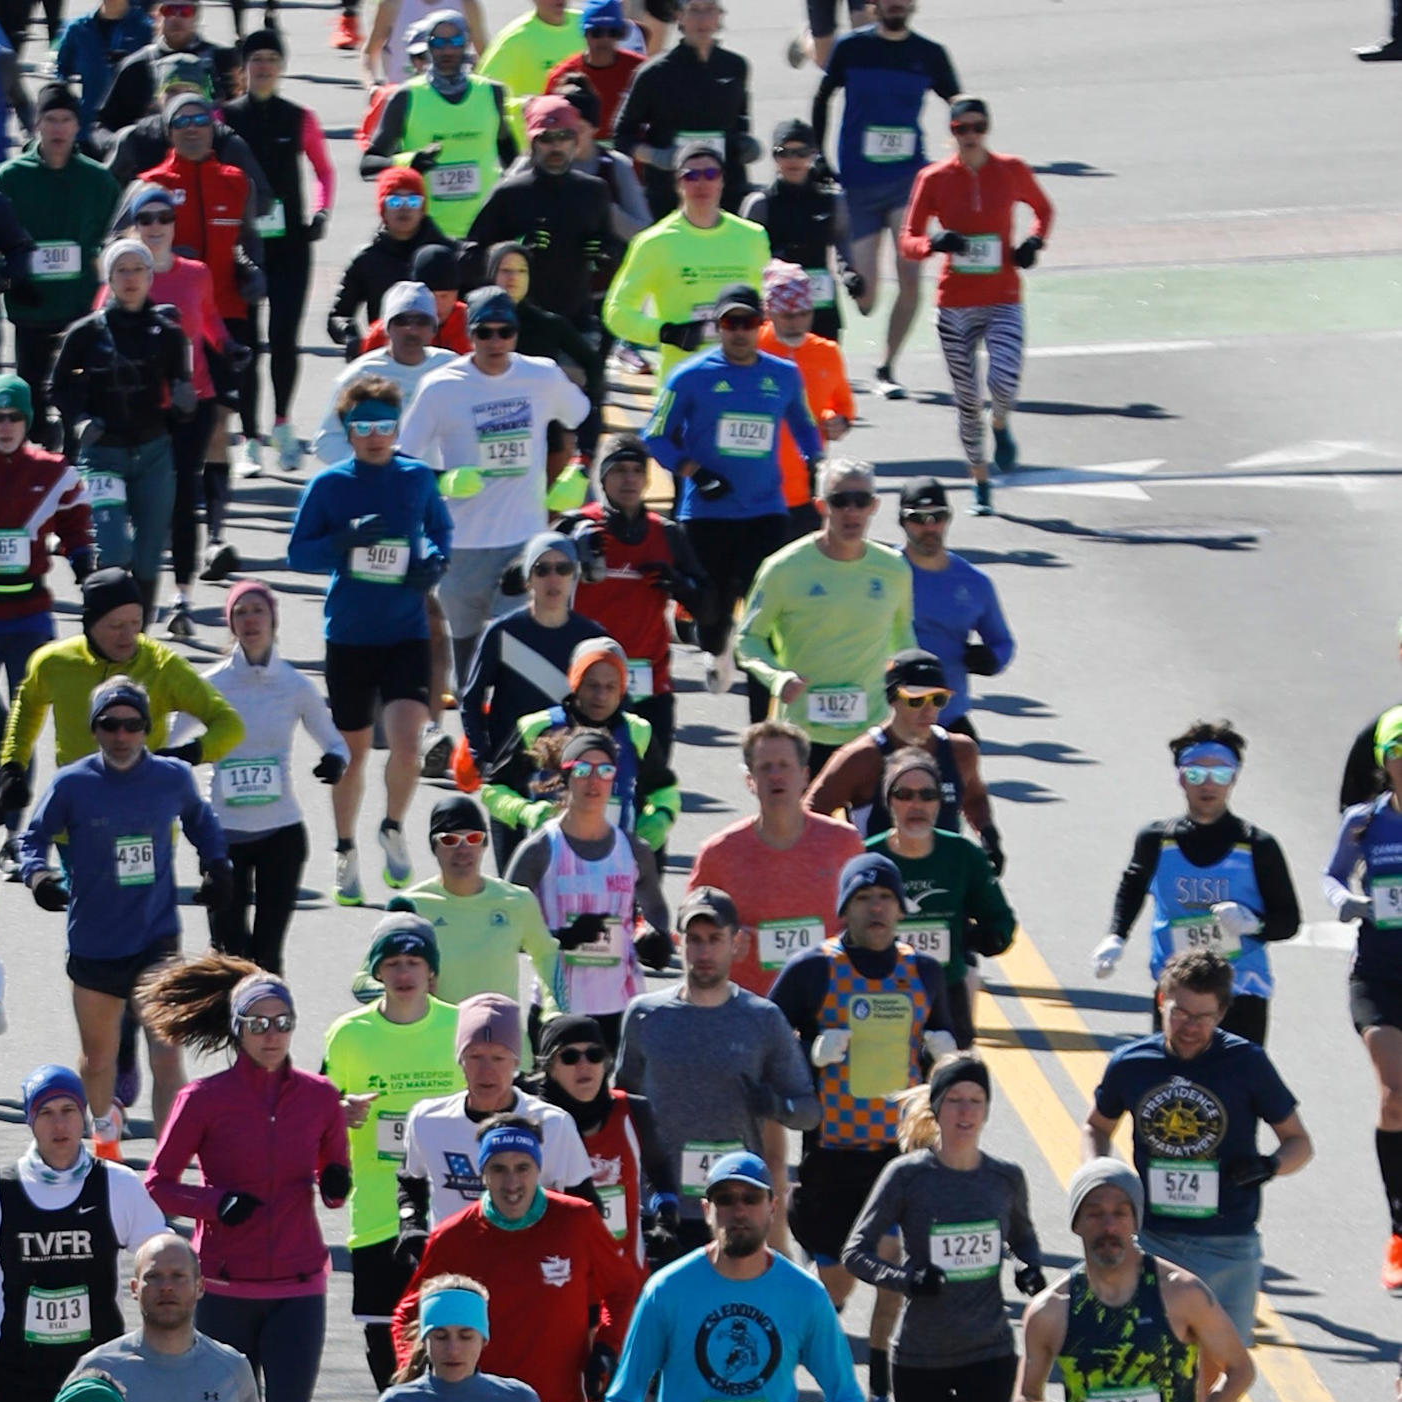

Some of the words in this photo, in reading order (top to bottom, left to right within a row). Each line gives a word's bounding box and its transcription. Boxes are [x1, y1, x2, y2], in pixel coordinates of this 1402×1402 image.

[367, 545, 399, 564] 909
[230, 768, 271, 787] 1173
[119, 845, 153, 865] 436
[773, 935, 810, 954] 570
[1189, 926, 1222, 946] 954
[1164, 1174, 1199, 1194] 574
[18, 1231, 93, 1256] TVFR
[942, 1234, 993, 1256] 1225
[35, 1299, 81, 1320] 1013
